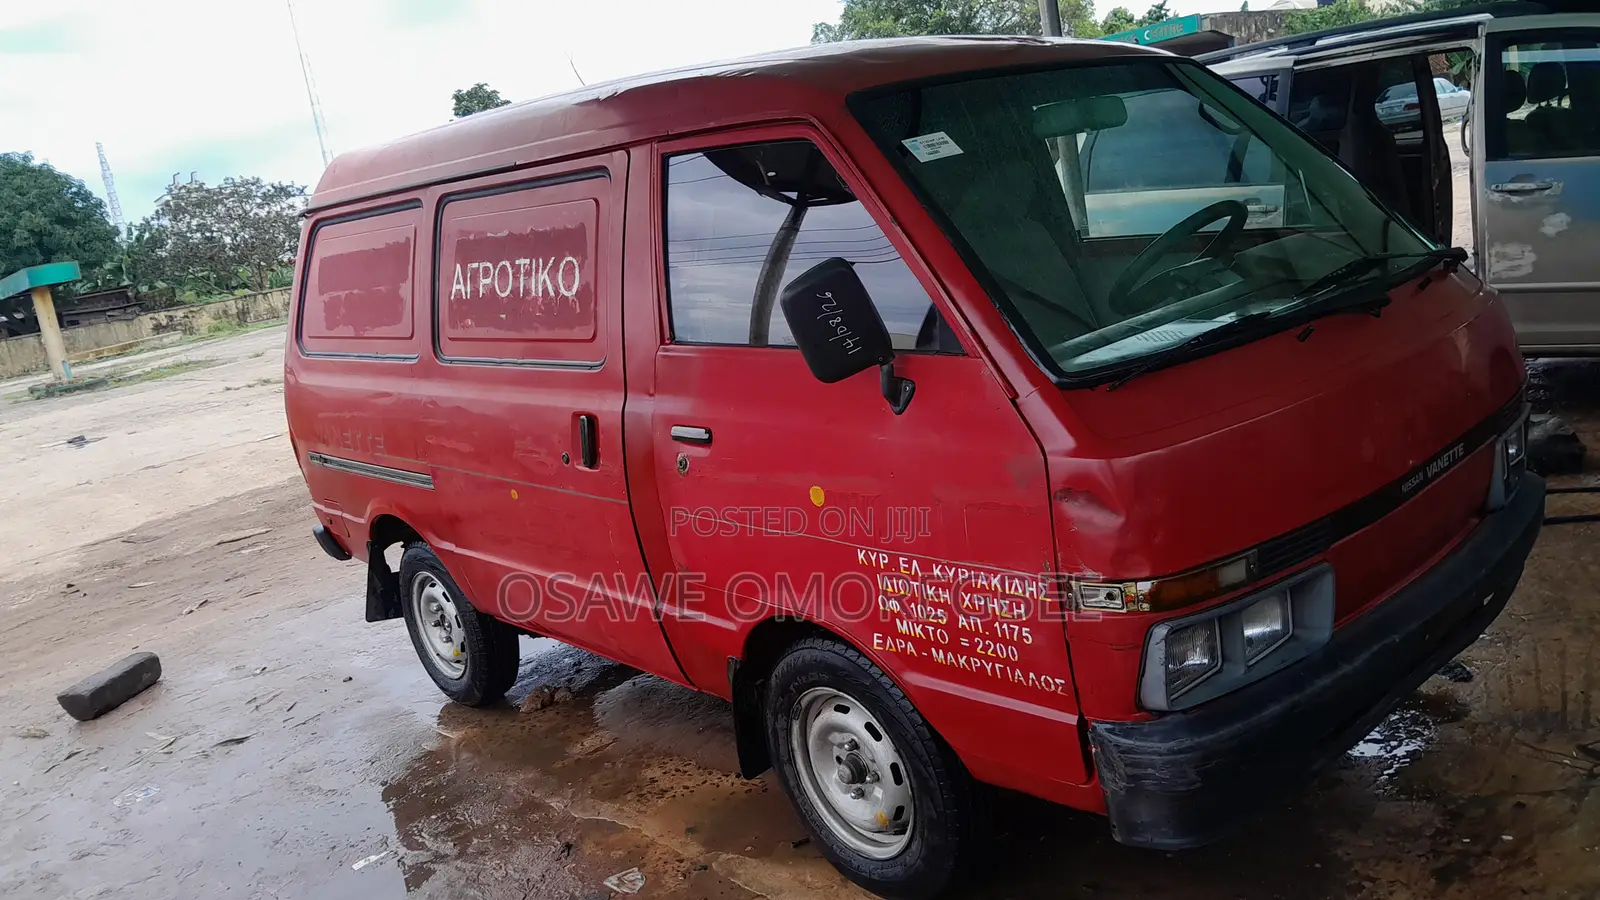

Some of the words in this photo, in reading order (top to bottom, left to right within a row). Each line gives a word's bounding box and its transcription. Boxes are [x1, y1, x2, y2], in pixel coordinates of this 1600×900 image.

[451, 256, 580, 300] ΑΓΡΟΤΙΚΟ
[1401, 471, 1424, 493] NISSAN
[1426, 442, 1465, 478] VANETTE
[932, 563, 1052, 602] ΚΥΡΙΑΚΙΔΗΣ
[961, 591, 1027, 621] ΧΡΗΣΗ
[896, 618, 949, 645] ΜΙΚΤΟ
